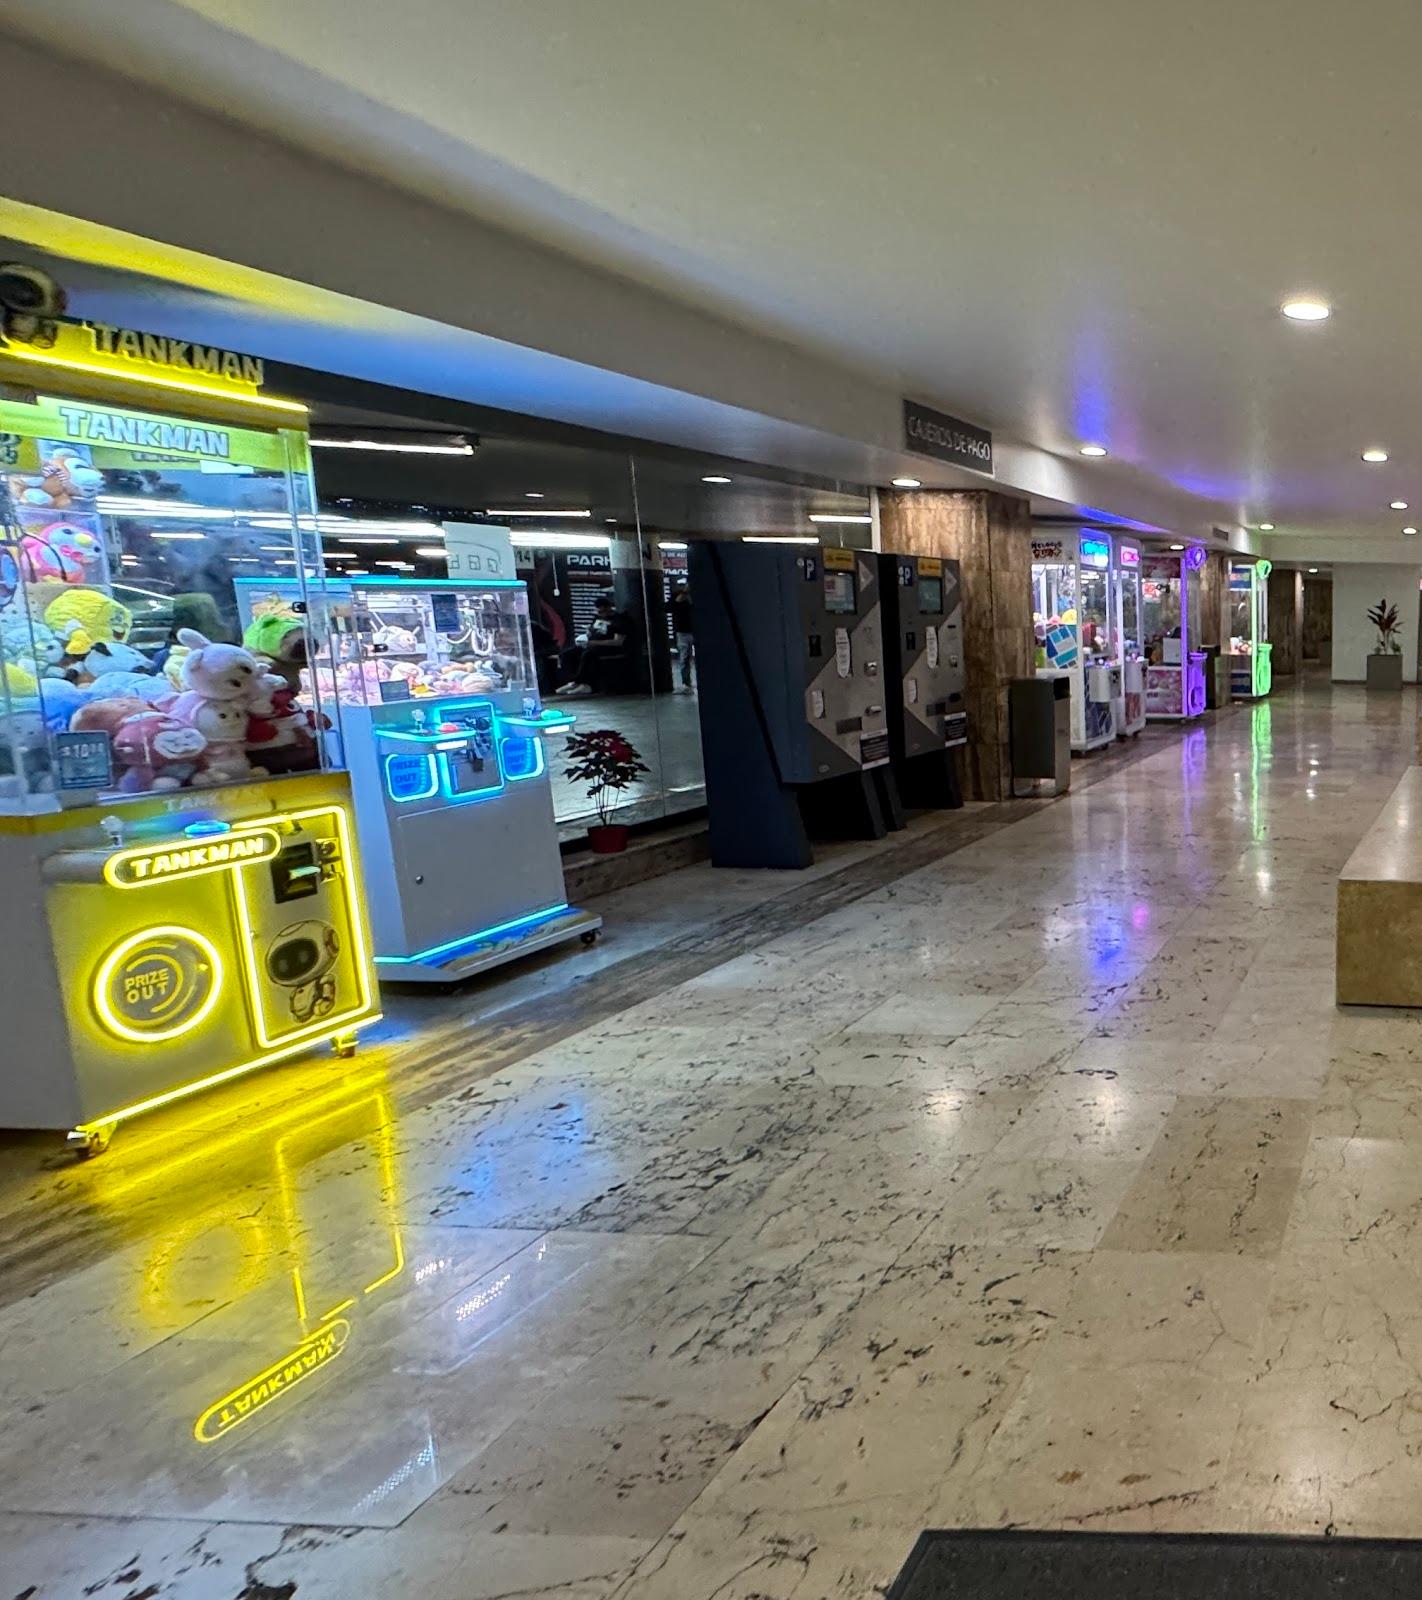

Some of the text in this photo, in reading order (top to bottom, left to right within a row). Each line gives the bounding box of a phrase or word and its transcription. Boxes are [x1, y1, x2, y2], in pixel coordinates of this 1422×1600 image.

[94, 322, 265, 386] TANKMAN
[60, 406, 230, 459] TANKMAN
[953, 431, 967, 453] DE
[967, 436, 991, 461] PAGO
[131, 837, 265, 878] TANKMAN
[124, 967, 170, 991] PRIZE
[126, 981, 170, 1004] OUT
